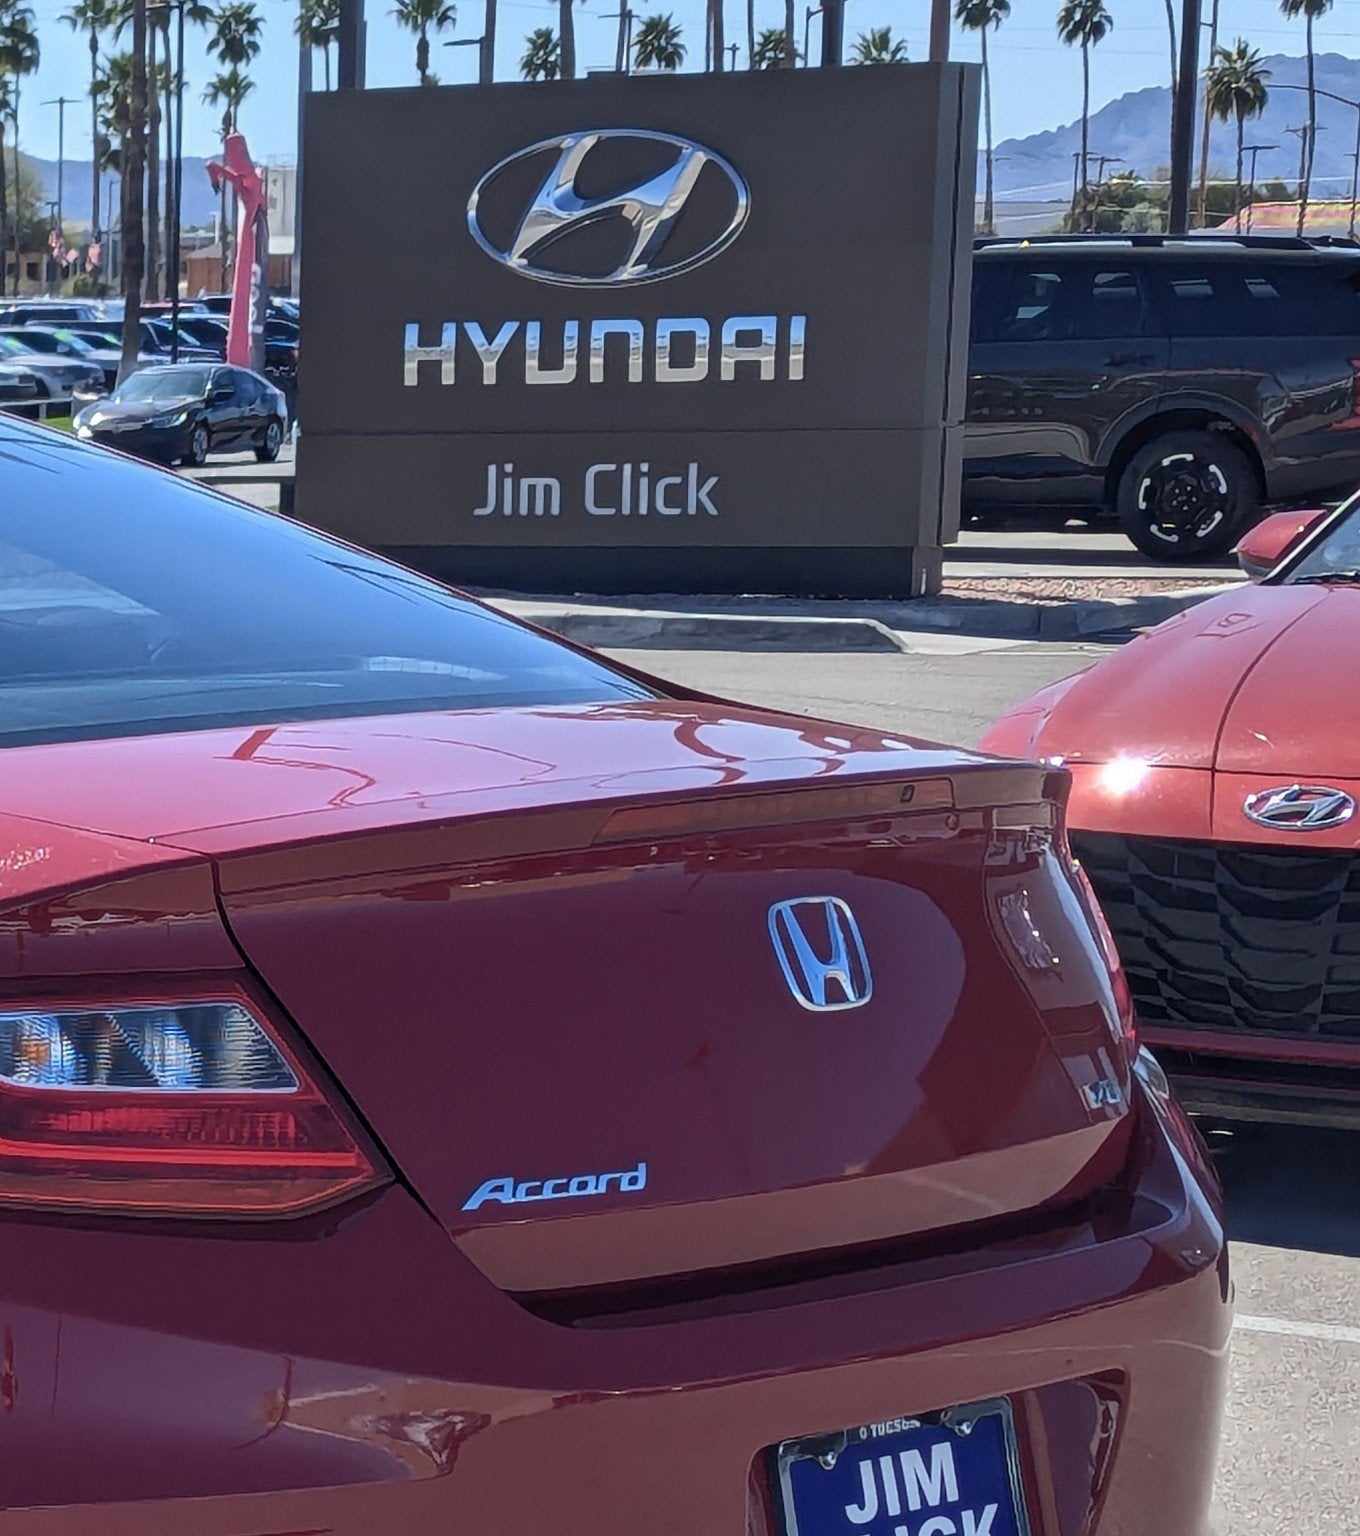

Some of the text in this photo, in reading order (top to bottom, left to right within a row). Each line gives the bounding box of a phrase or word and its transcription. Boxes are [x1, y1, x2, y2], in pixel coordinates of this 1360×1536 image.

[403, 315, 807, 387] HYUNDAI
[473, 461, 720, 517] Jim Click
[460, 1162, 647, 1212] Accord
[844, 1441, 960, 1524] JIM
